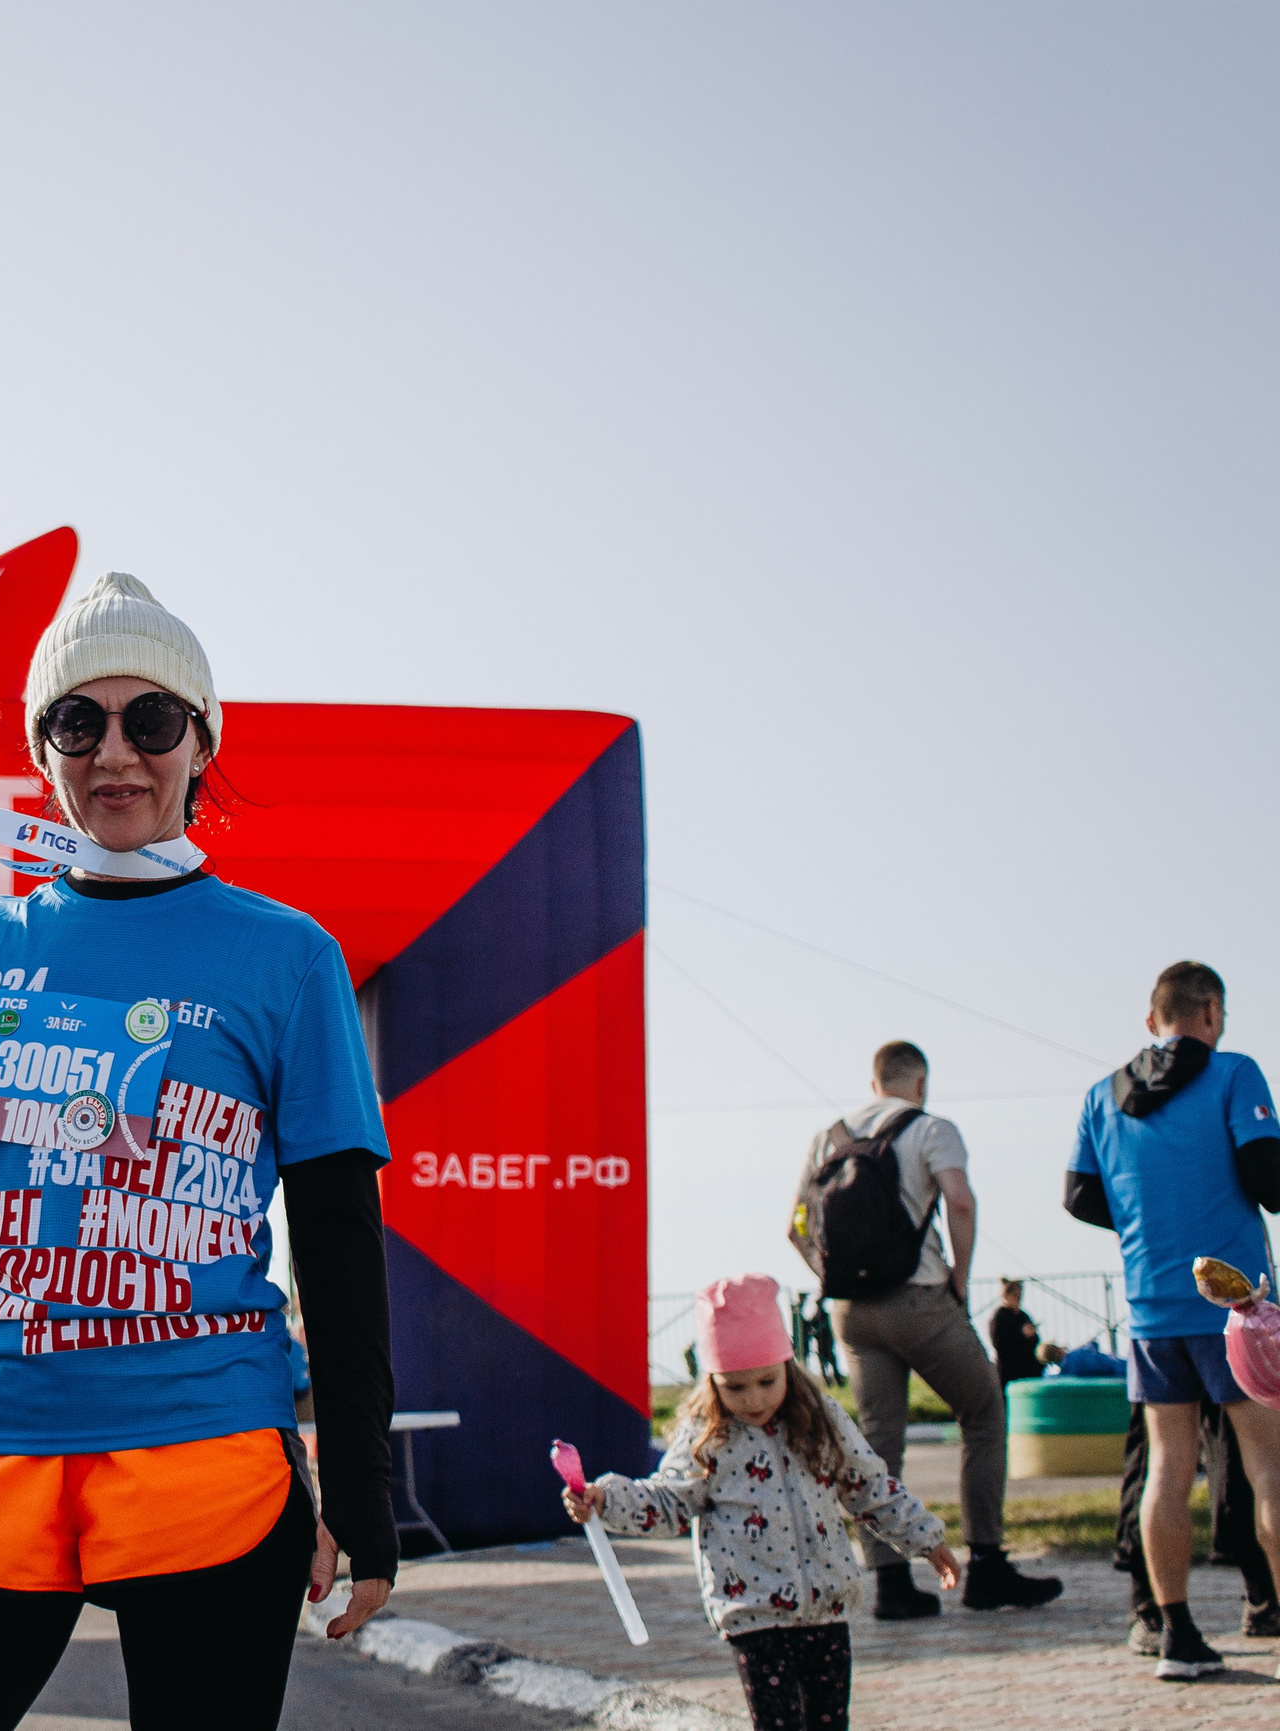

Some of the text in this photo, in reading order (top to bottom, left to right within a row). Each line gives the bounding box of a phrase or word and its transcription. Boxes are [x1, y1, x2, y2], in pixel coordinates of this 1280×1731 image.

[41, 831, 77, 854] ПСБ
[0, 997, 28, 1010] ПСБ
[155, 1080, 263, 1164] #ЦЕЛЬ
[412, 1151, 631, 1190] ЗАБЕГ.РФ
